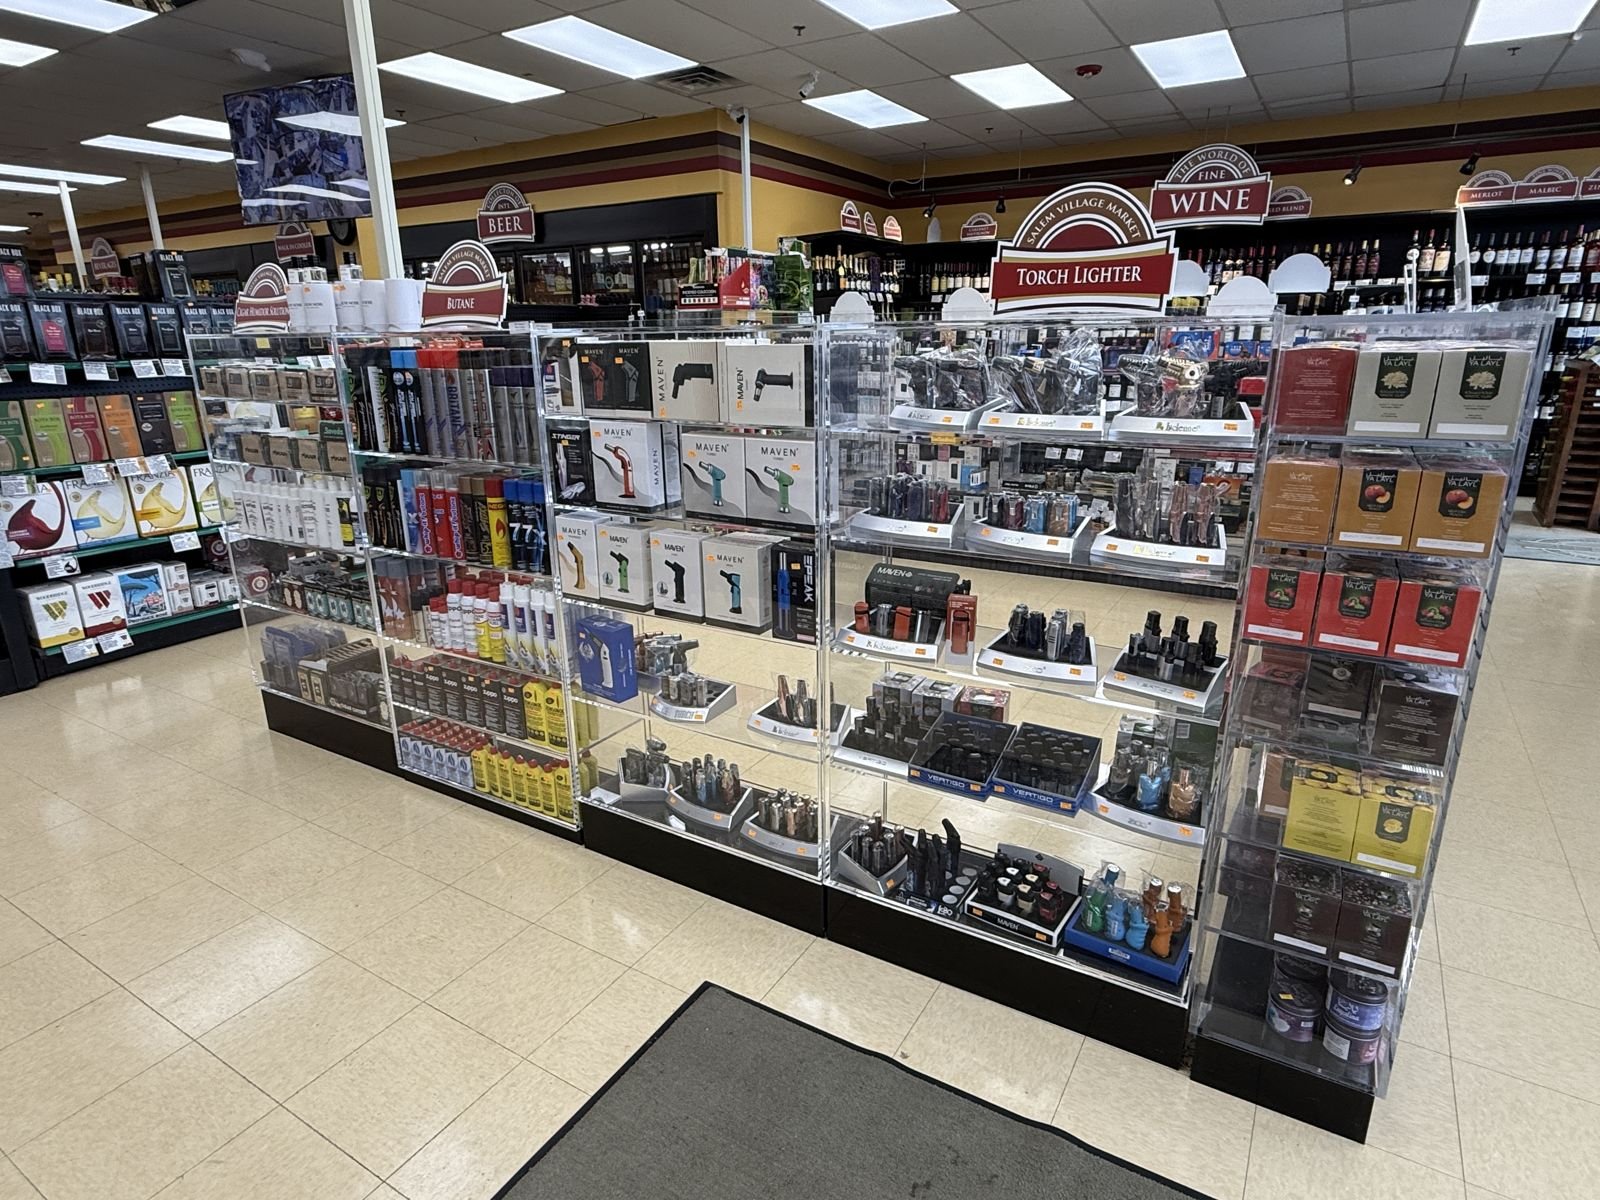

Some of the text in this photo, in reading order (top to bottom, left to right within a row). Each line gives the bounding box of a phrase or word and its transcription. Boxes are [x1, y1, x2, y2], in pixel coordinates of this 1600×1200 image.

[1174, 150, 1251, 179] THE WORLD OF
[1198, 169, 1227, 181] FINE
[1169, 188, 1251, 214] WINE
[1470, 190, 1504, 199] MERLOT
[488, 215, 523, 234] BEER
[1027, 198, 1141, 245] SALEM VILLAGE MARKET
[452, 251, 474, 262] VILLAGE
[475, 254, 491, 278] MARKET
[1016, 265, 1142, 286] TORCH LIGHTER
[33, 304, 50, 313] BLACK
[447, 297, 476, 310] BUTANE
[115, 307, 131, 315] BLACK
[736, 368, 744, 400] MAVEN
[604, 428, 632, 437] MAVEN
[696, 442, 728, 453] MAVEN
[761, 447, 797, 457] MAVEN
[651, 449, 660, 485] MAVEN
[562, 527, 587, 536] MAVEN
[609, 535, 628, 544] MAVEN
[664, 543, 684, 552] MAVEN
[716, 554, 743, 564] MAVEN
[803, 555, 814, 602] EPEAK
[877, 567, 906, 577] MAVEN
[927, 773, 966, 789] VERTIGO
[1013, 787, 1054, 803] VERTIGO
[997, 917, 1018, 930] MAVEN
